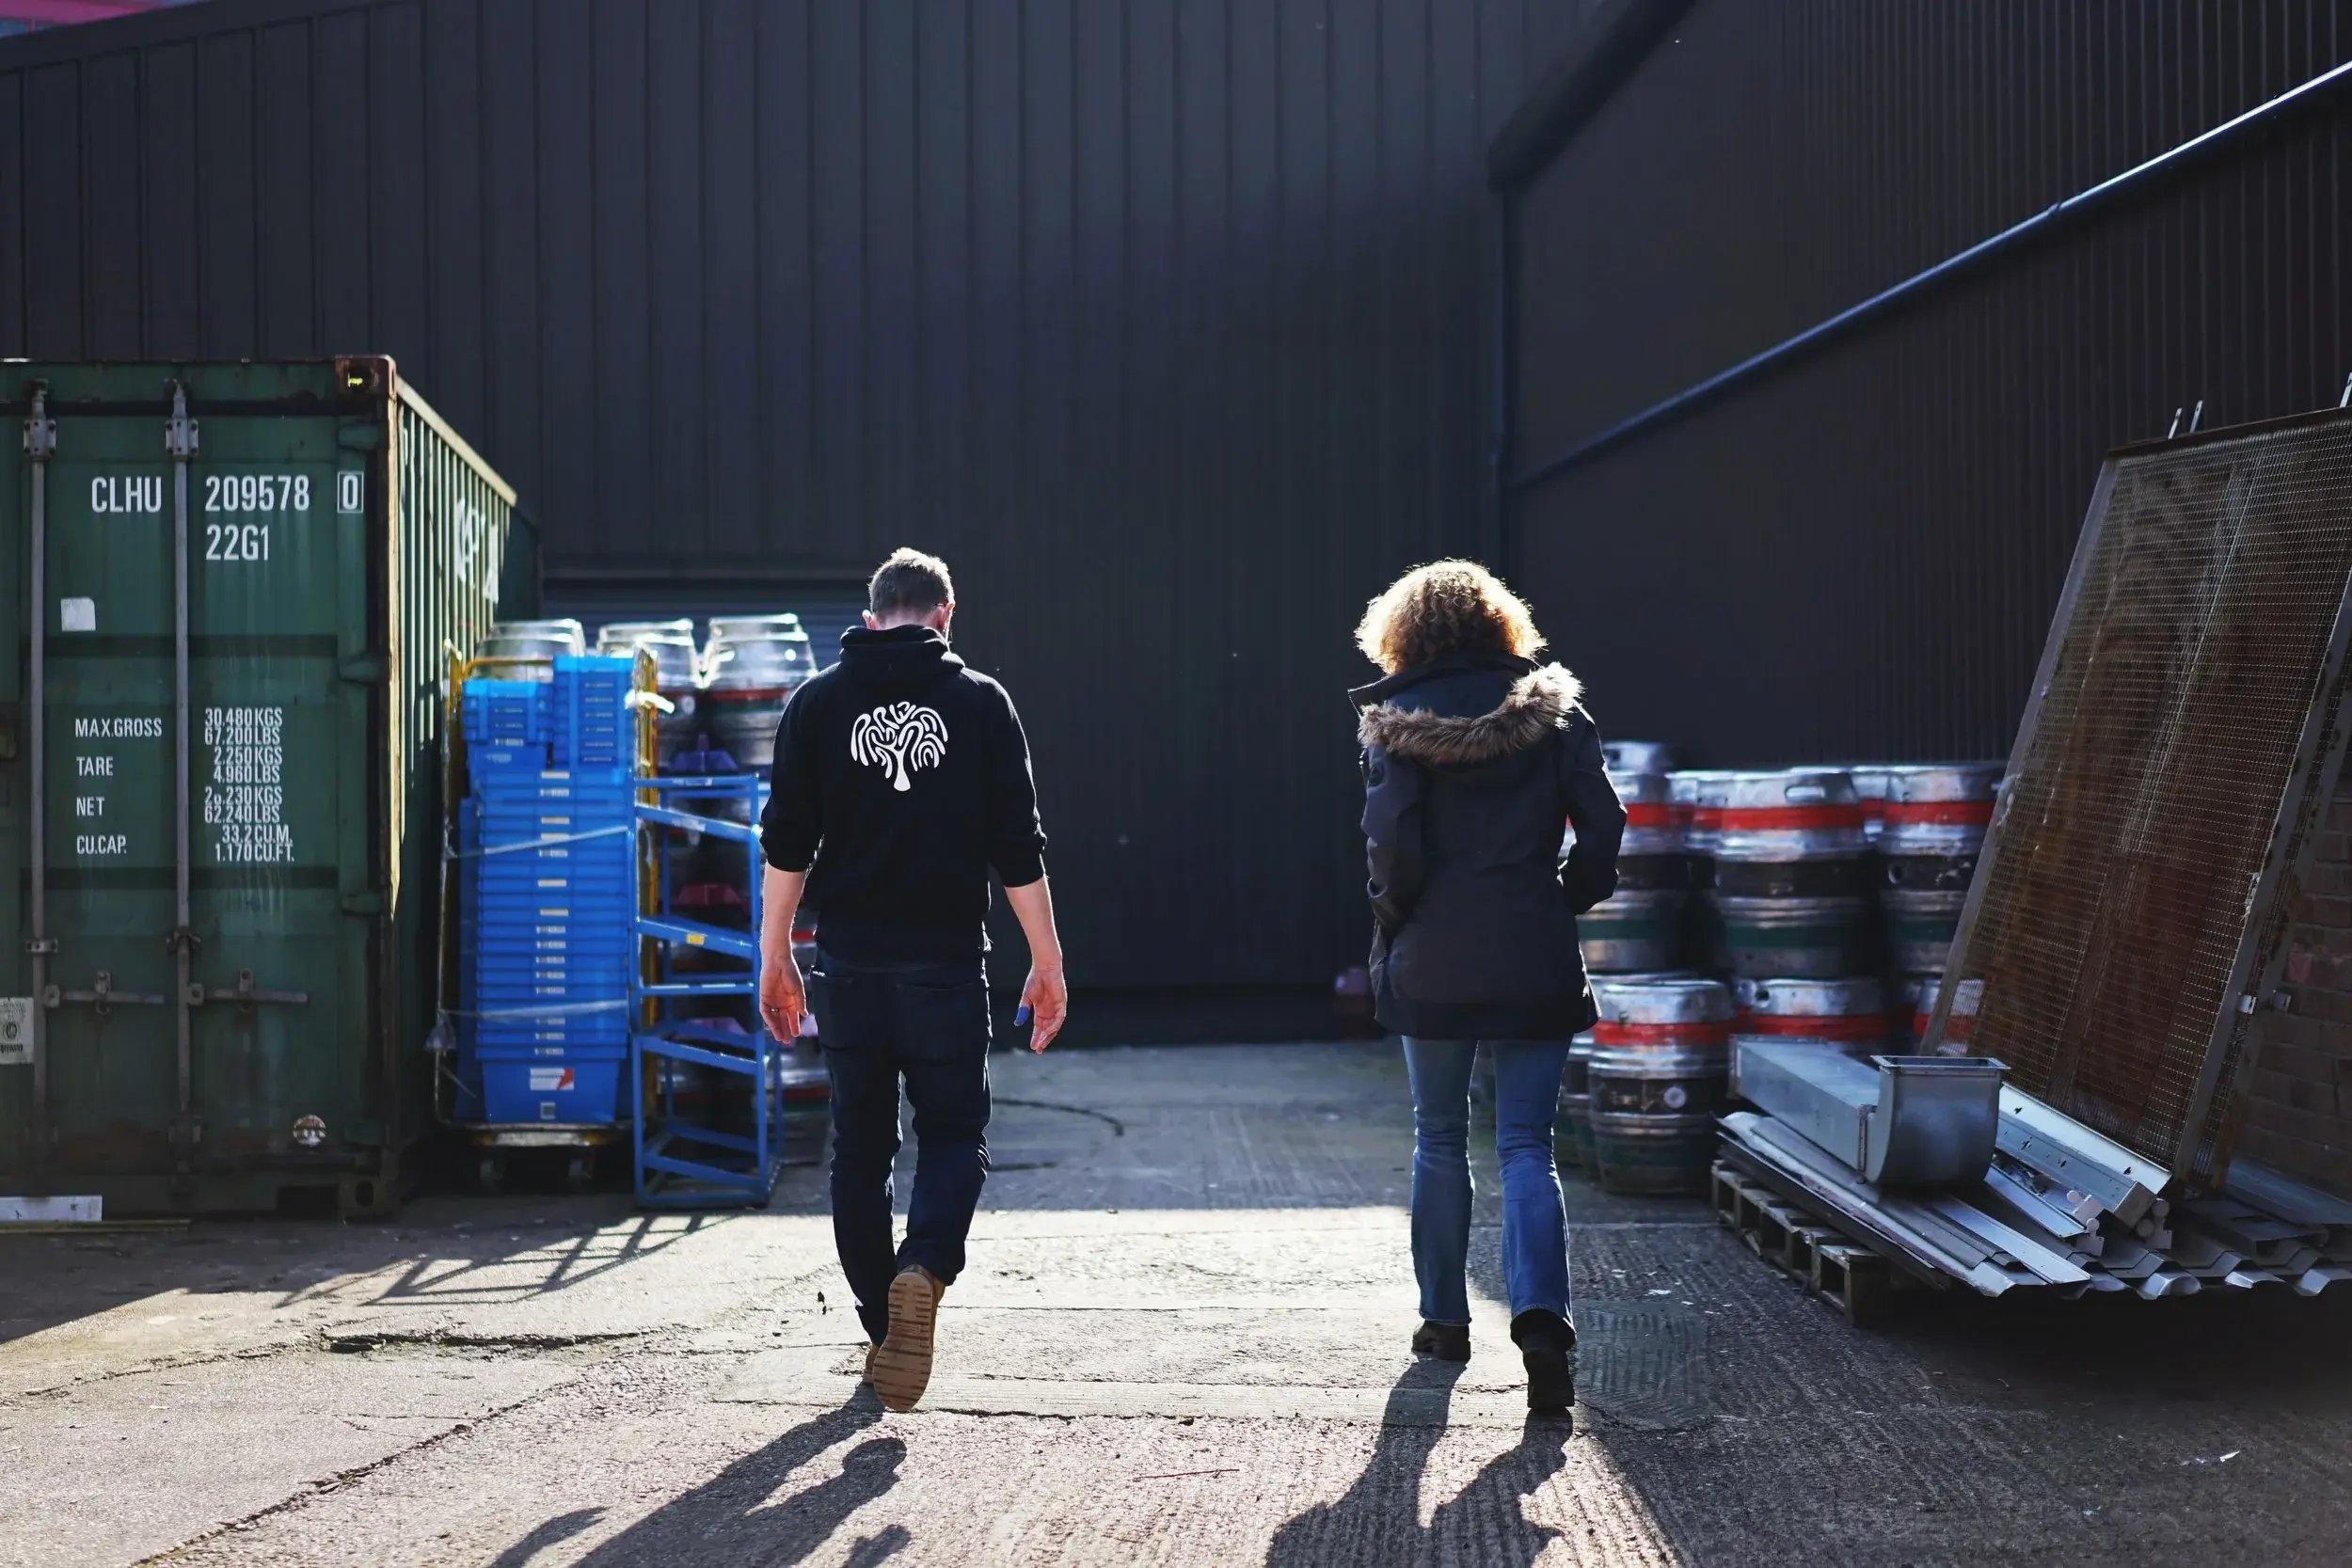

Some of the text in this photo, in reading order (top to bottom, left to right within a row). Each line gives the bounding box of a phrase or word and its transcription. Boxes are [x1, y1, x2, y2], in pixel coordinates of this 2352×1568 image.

[91, 473, 359, 513] CLHU 209578 0
[205, 524, 269, 561] 22G1
[76, 756, 114, 776] TARE
[76, 797, 104, 816] NET
